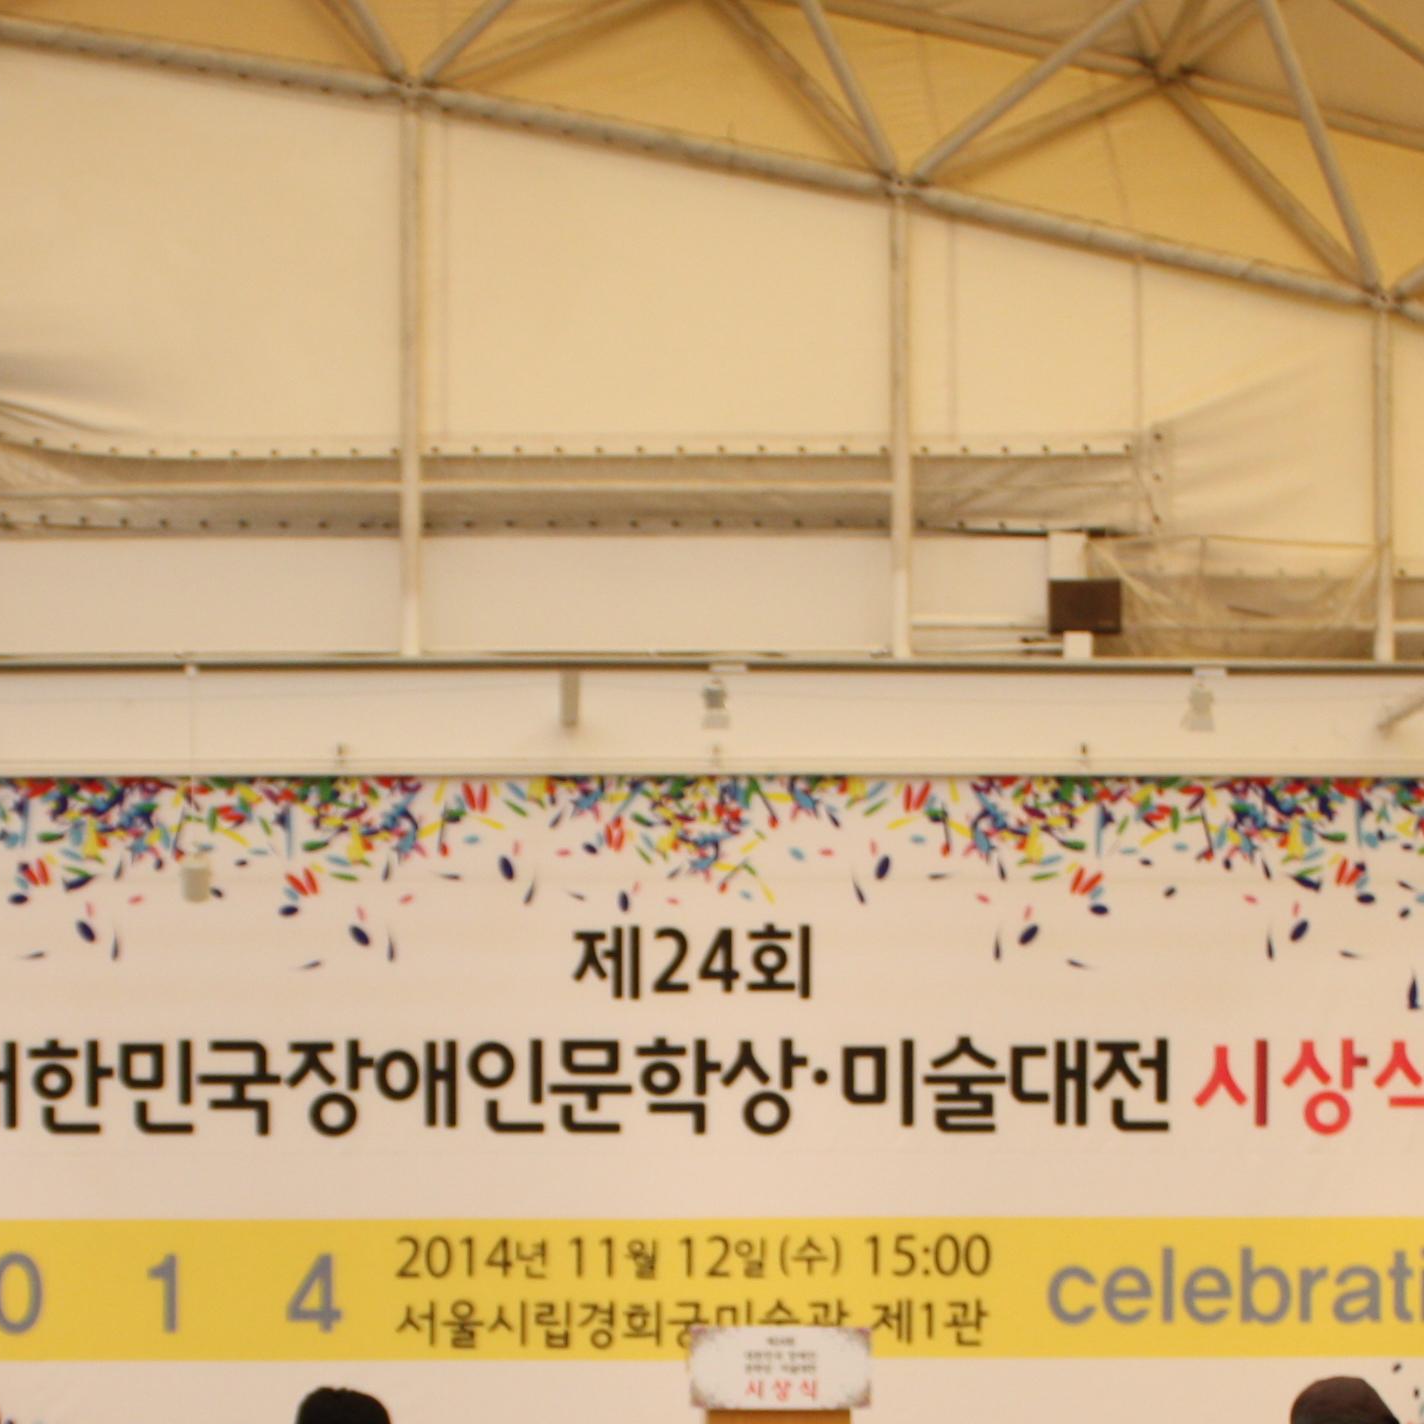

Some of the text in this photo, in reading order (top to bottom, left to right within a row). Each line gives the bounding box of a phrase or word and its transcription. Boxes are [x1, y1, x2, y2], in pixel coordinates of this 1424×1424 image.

[573, 924, 813, 999] 제24회
[395, 1234, 548, 1279] 2014년
[569, 1236, 658, 1279] 11월
[866, 1233, 991, 1277] 15:00
[874, 1298, 988, 1347] 제1관
